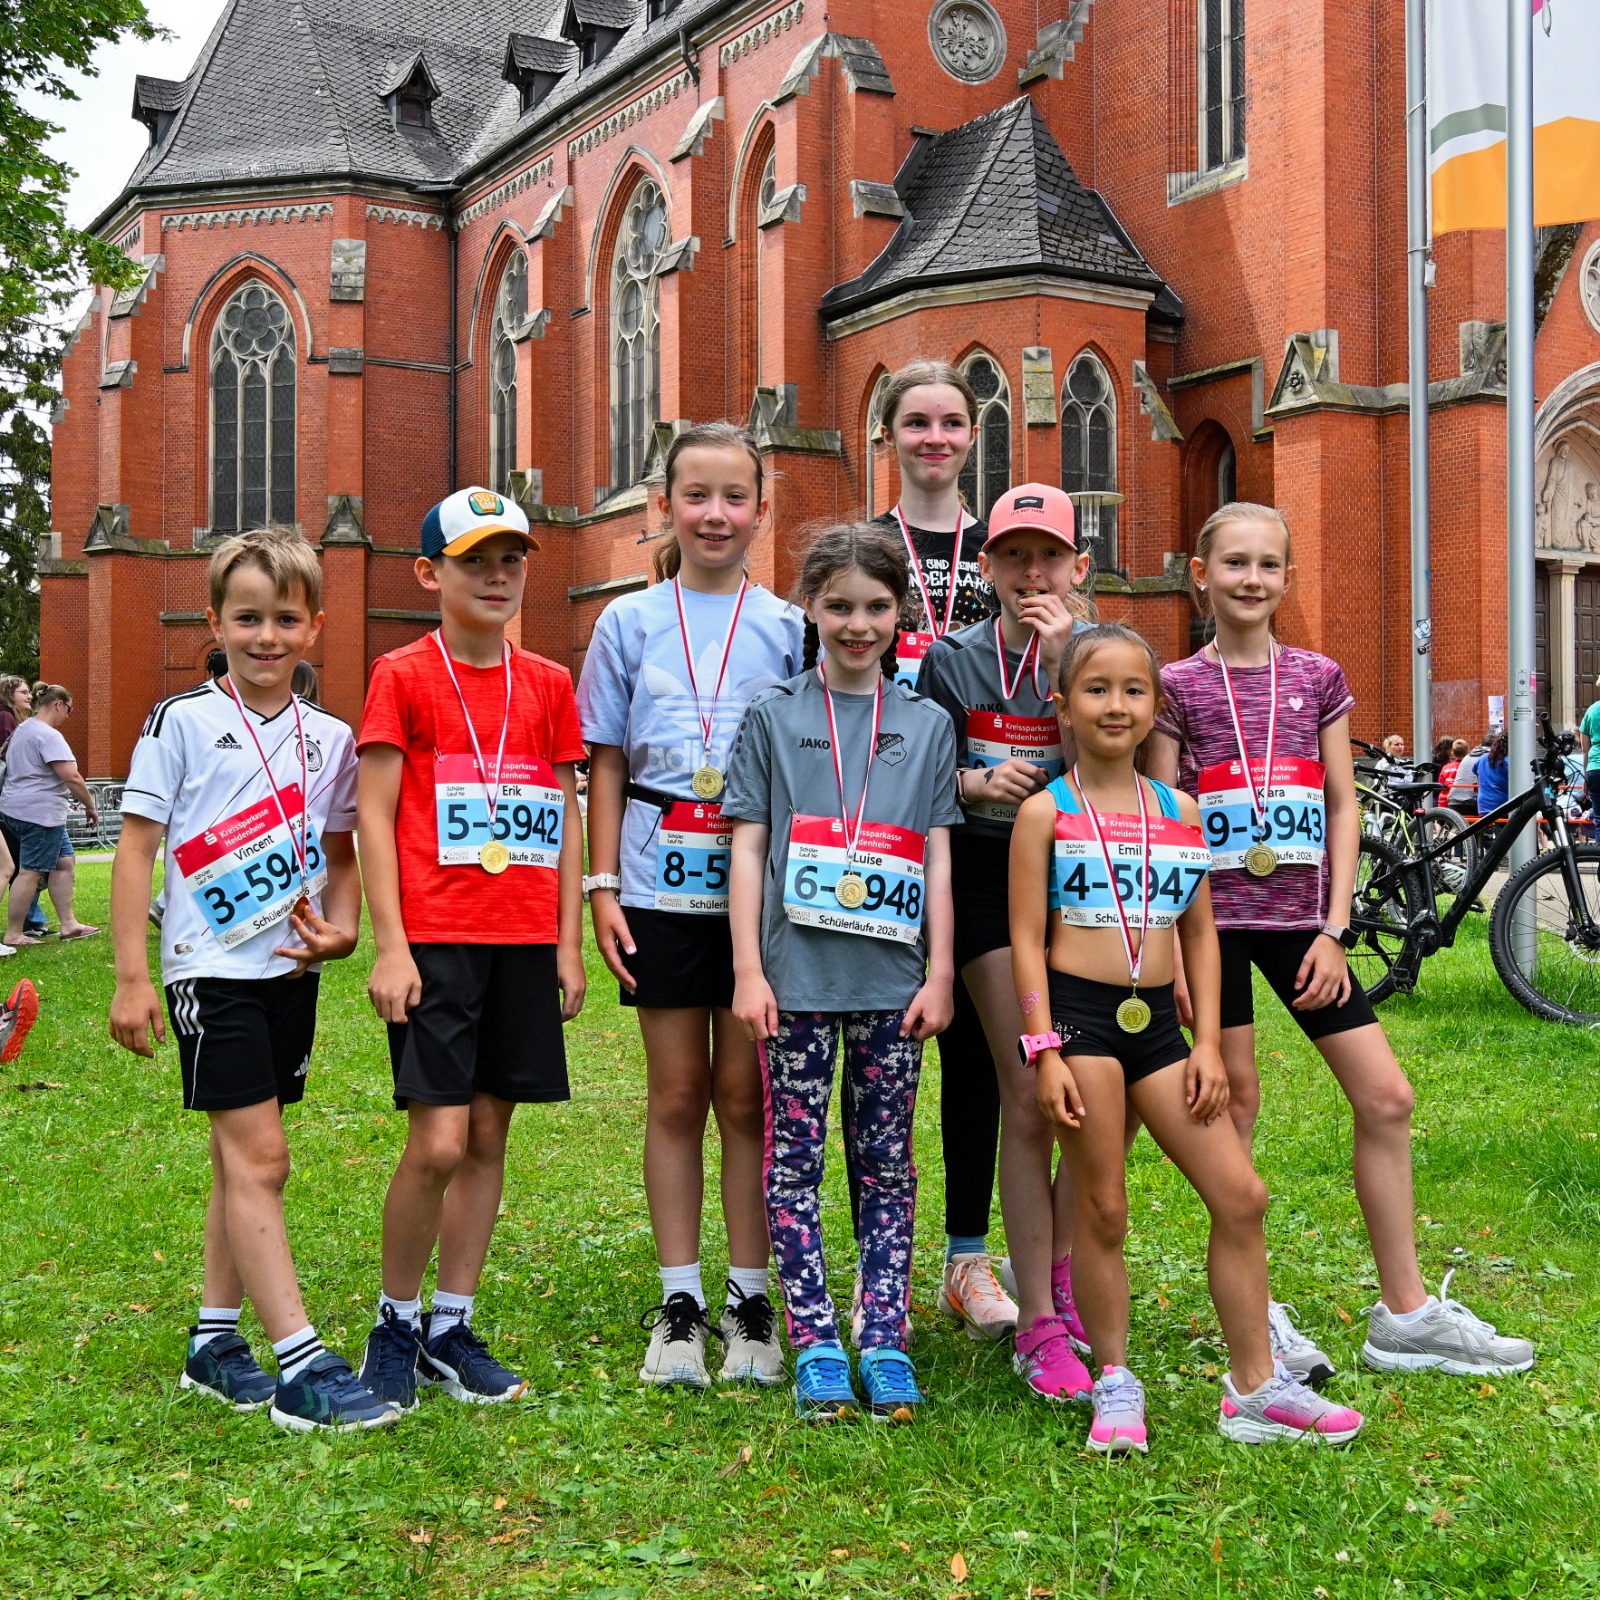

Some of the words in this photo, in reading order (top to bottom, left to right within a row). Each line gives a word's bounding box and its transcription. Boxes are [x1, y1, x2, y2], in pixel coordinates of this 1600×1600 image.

[926, 558, 949, 570] SIND
[955, 560, 980, 573] EINE
[927, 588, 943, 596] DAS
[1005, 732, 1049, 741] Heidenheim
[799, 738, 831, 749] JAKO
[648, 739, 728, 773] adid
[1010, 746, 1045, 758] Emma
[488, 772, 531, 780] Hedenheim
[502, 785, 522, 797] Erik
[544, 792, 549, 800] M
[1257, 788, 1285, 798] Kara
[219, 808, 269, 838] Kreissparkasse
[447, 804, 559, 846] 5-5942
[1109, 819, 1166, 831] Kreisspaasse
[1206, 805, 1322, 847] 9-5943
[225, 822, 265, 847] Heidenheim
[1110, 830, 1156, 839] Heidenhm
[234, 834, 275, 861] Vincent
[530, 853, 545, 863] 2026
[853, 852, 883, 866] Luise
[1179, 851, 1188, 859] W
[1190, 851, 1211, 861] 2018
[1296, 851, 1312, 860] 2026
[906, 865, 913, 873] W
[204, 832, 320, 925] 3-5945
[1063, 862, 1206, 905] 4-5947
[794, 865, 921, 920] 6-948
[818, 914, 875, 934] Schülerläufe
[1155, 916, 1173, 925] 2026
[876, 924, 898, 937] 2026
